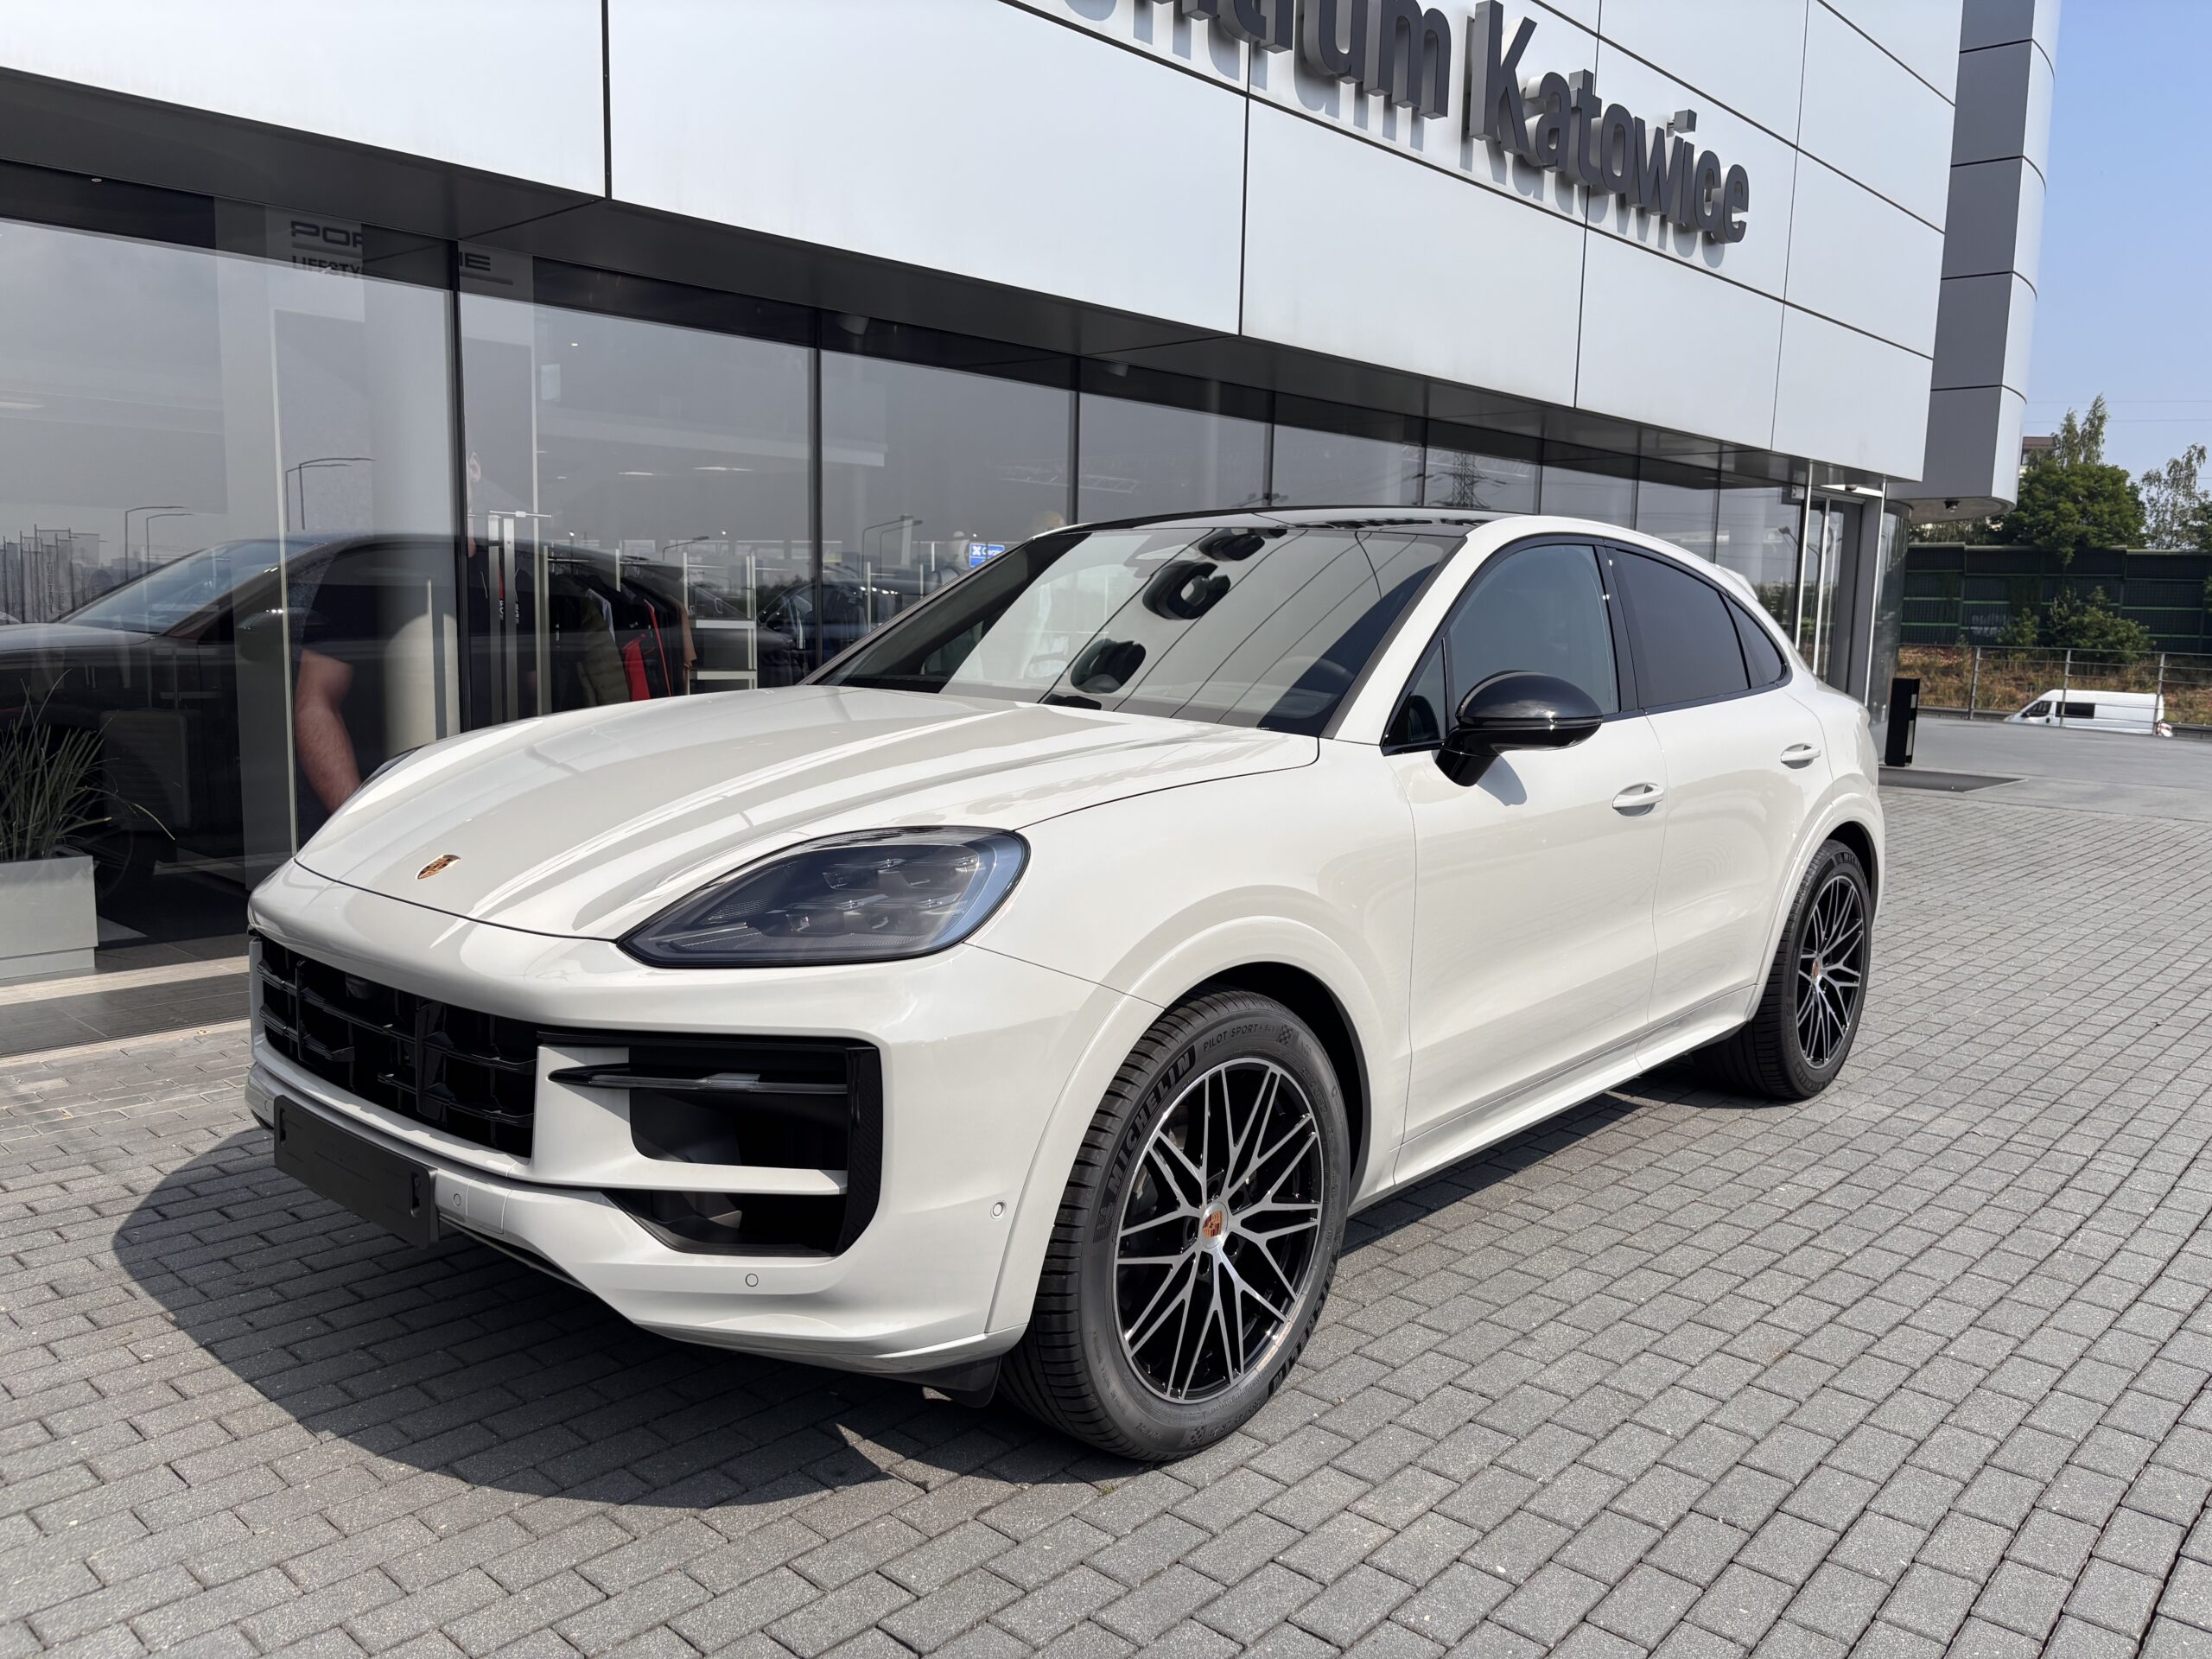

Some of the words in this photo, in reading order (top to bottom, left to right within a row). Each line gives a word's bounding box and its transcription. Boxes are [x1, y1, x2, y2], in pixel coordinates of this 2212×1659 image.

[1474, 0, 1750, 245] Katowice
[1203, 1030, 1227, 1052] PILOT
[1231, 1024, 1259, 1037] SPORT
[1107, 1049, 1192, 1195] MICHELIN
